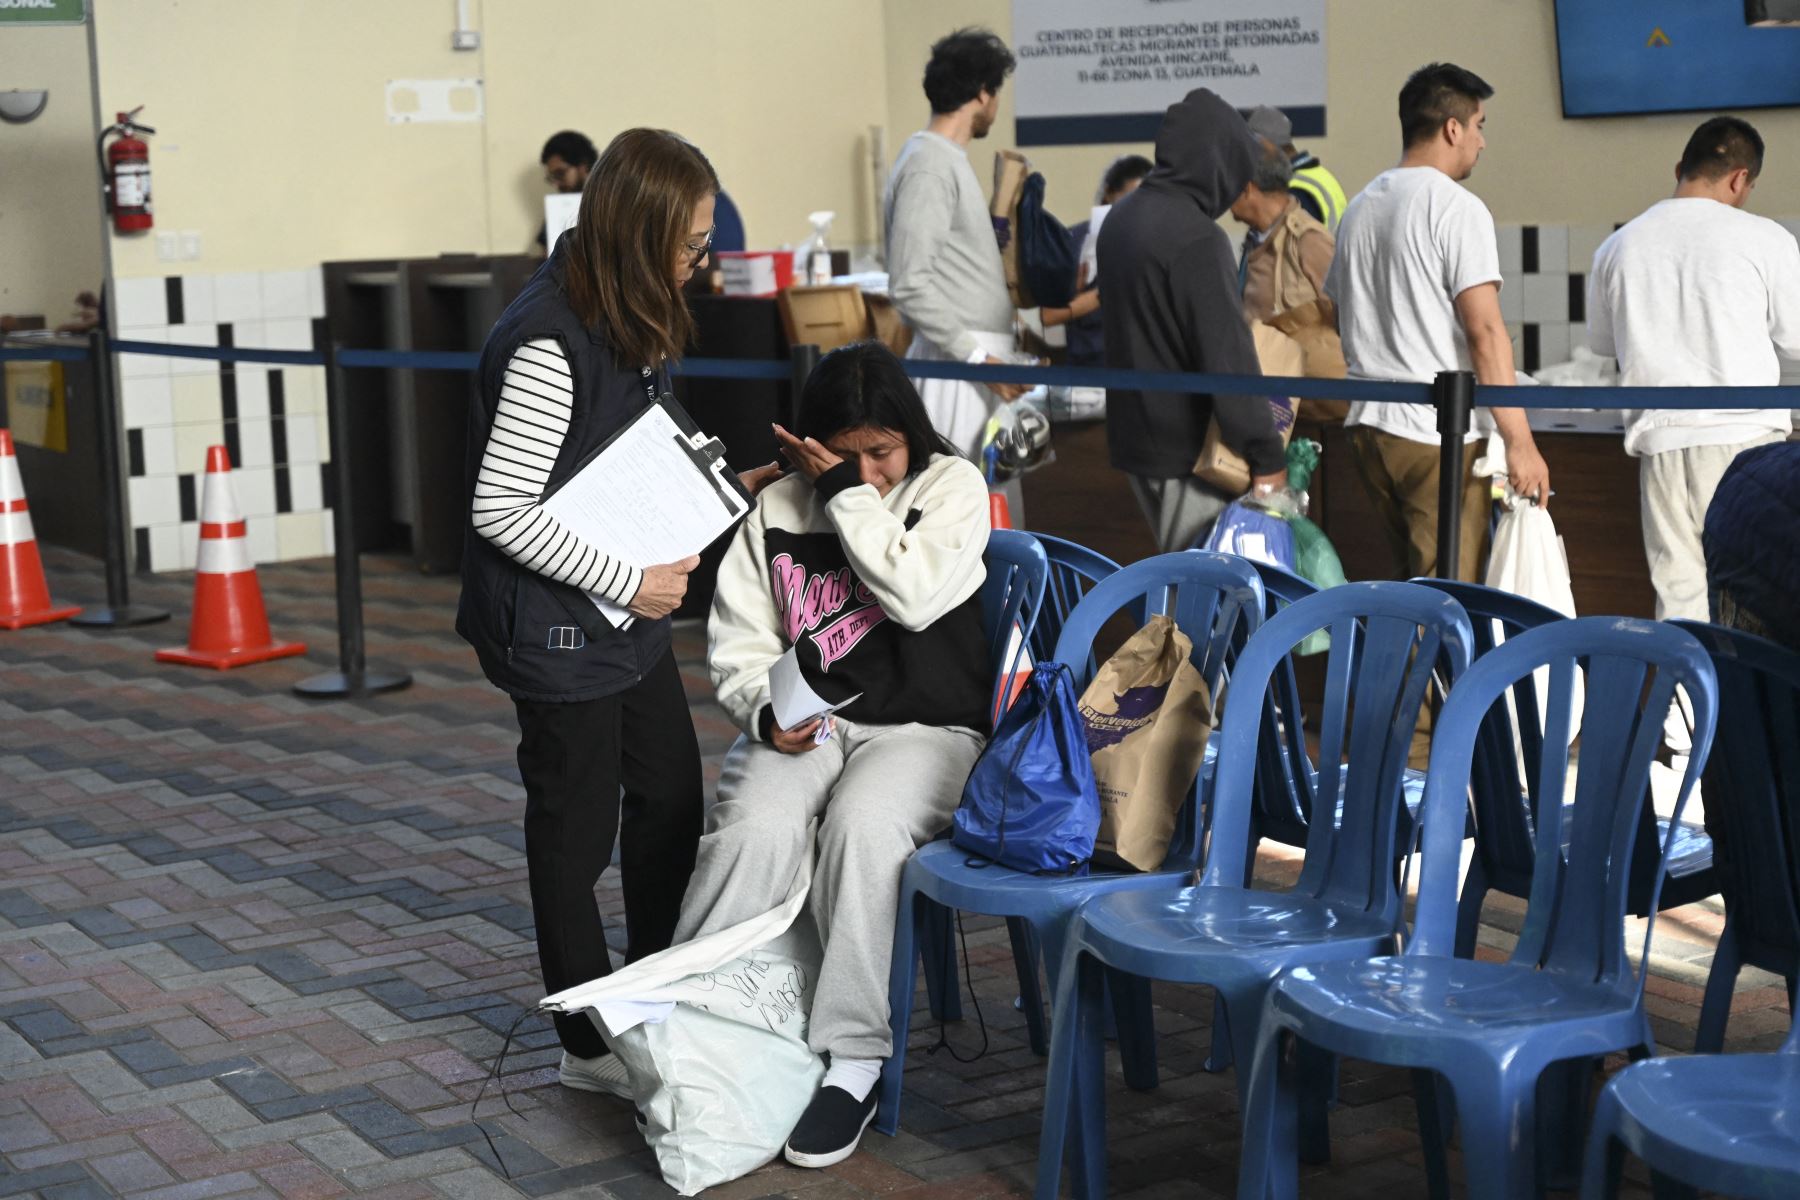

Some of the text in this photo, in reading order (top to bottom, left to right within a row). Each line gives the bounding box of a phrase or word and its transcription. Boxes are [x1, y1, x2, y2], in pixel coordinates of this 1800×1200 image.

[1036, 28, 1093, 43] CENTRO
[1096, 26, 1114, 40] DE
[1202, 21, 1219, 35] DE
[1224, 16, 1301, 33] PERSONAS
[1020, 30, 1320, 58] GUATEMALTECAS MIGRANTES RETORNADAS
[1099, 54, 1162, 68] AVENIDA
[1113, 67, 1152, 82] ZONA
[1174, 62, 1261, 79] GUATEMALA
[771, 553, 852, 646] New
